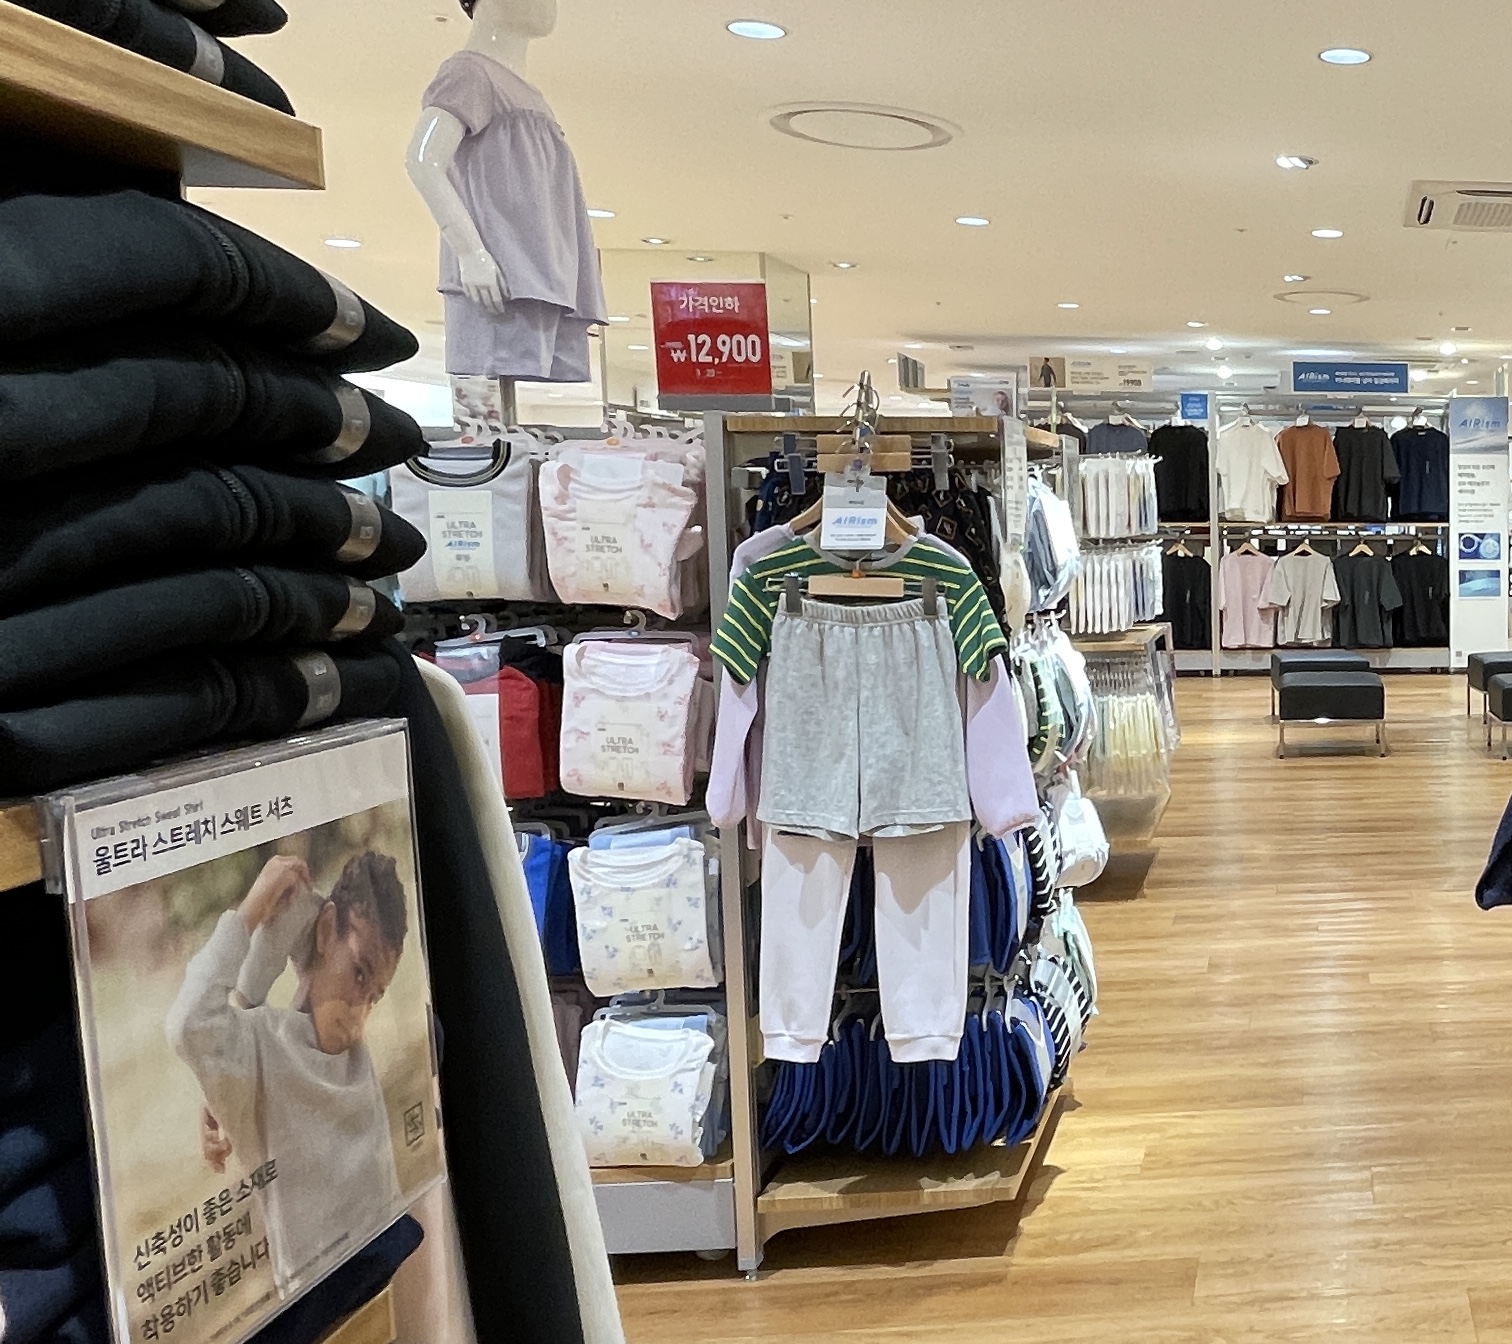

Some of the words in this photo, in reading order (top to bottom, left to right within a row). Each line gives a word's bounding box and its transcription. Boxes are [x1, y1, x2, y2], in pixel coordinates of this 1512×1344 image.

[679, 296, 740, 313] 가격인하
[670, 334, 761, 365] ₩12,900
[1458, 418, 1501, 429] AIRism
[446, 521, 477, 530] ULTRA
[832, 516, 878, 525] AIRism
[442, 530, 482, 539] STRETCH
[590, 535, 618, 544] ULTRA
[585, 544, 622, 553] STRETCH
[606, 736, 634, 745] ULTRA
[93, 834, 148, 876] 울트라
[152, 815, 216, 856] 스트레치
[220, 804, 263, 835] 스웨트
[266, 795, 294, 821] 셔츠
[629, 924, 659, 933] ULTRA
[625, 932, 665, 943] STRETCH
[626, 1110, 653, 1118] ULTRA
[133, 1207, 200, 1271] 신축성이
[202, 1188, 233, 1226] 좋은
[236, 1159, 278, 1203] 소재로
[136, 1244, 203, 1304] 액티브한
[140, 1279, 209, 1341] 착용하기
[210, 1236, 270, 1296] 좋습니다
